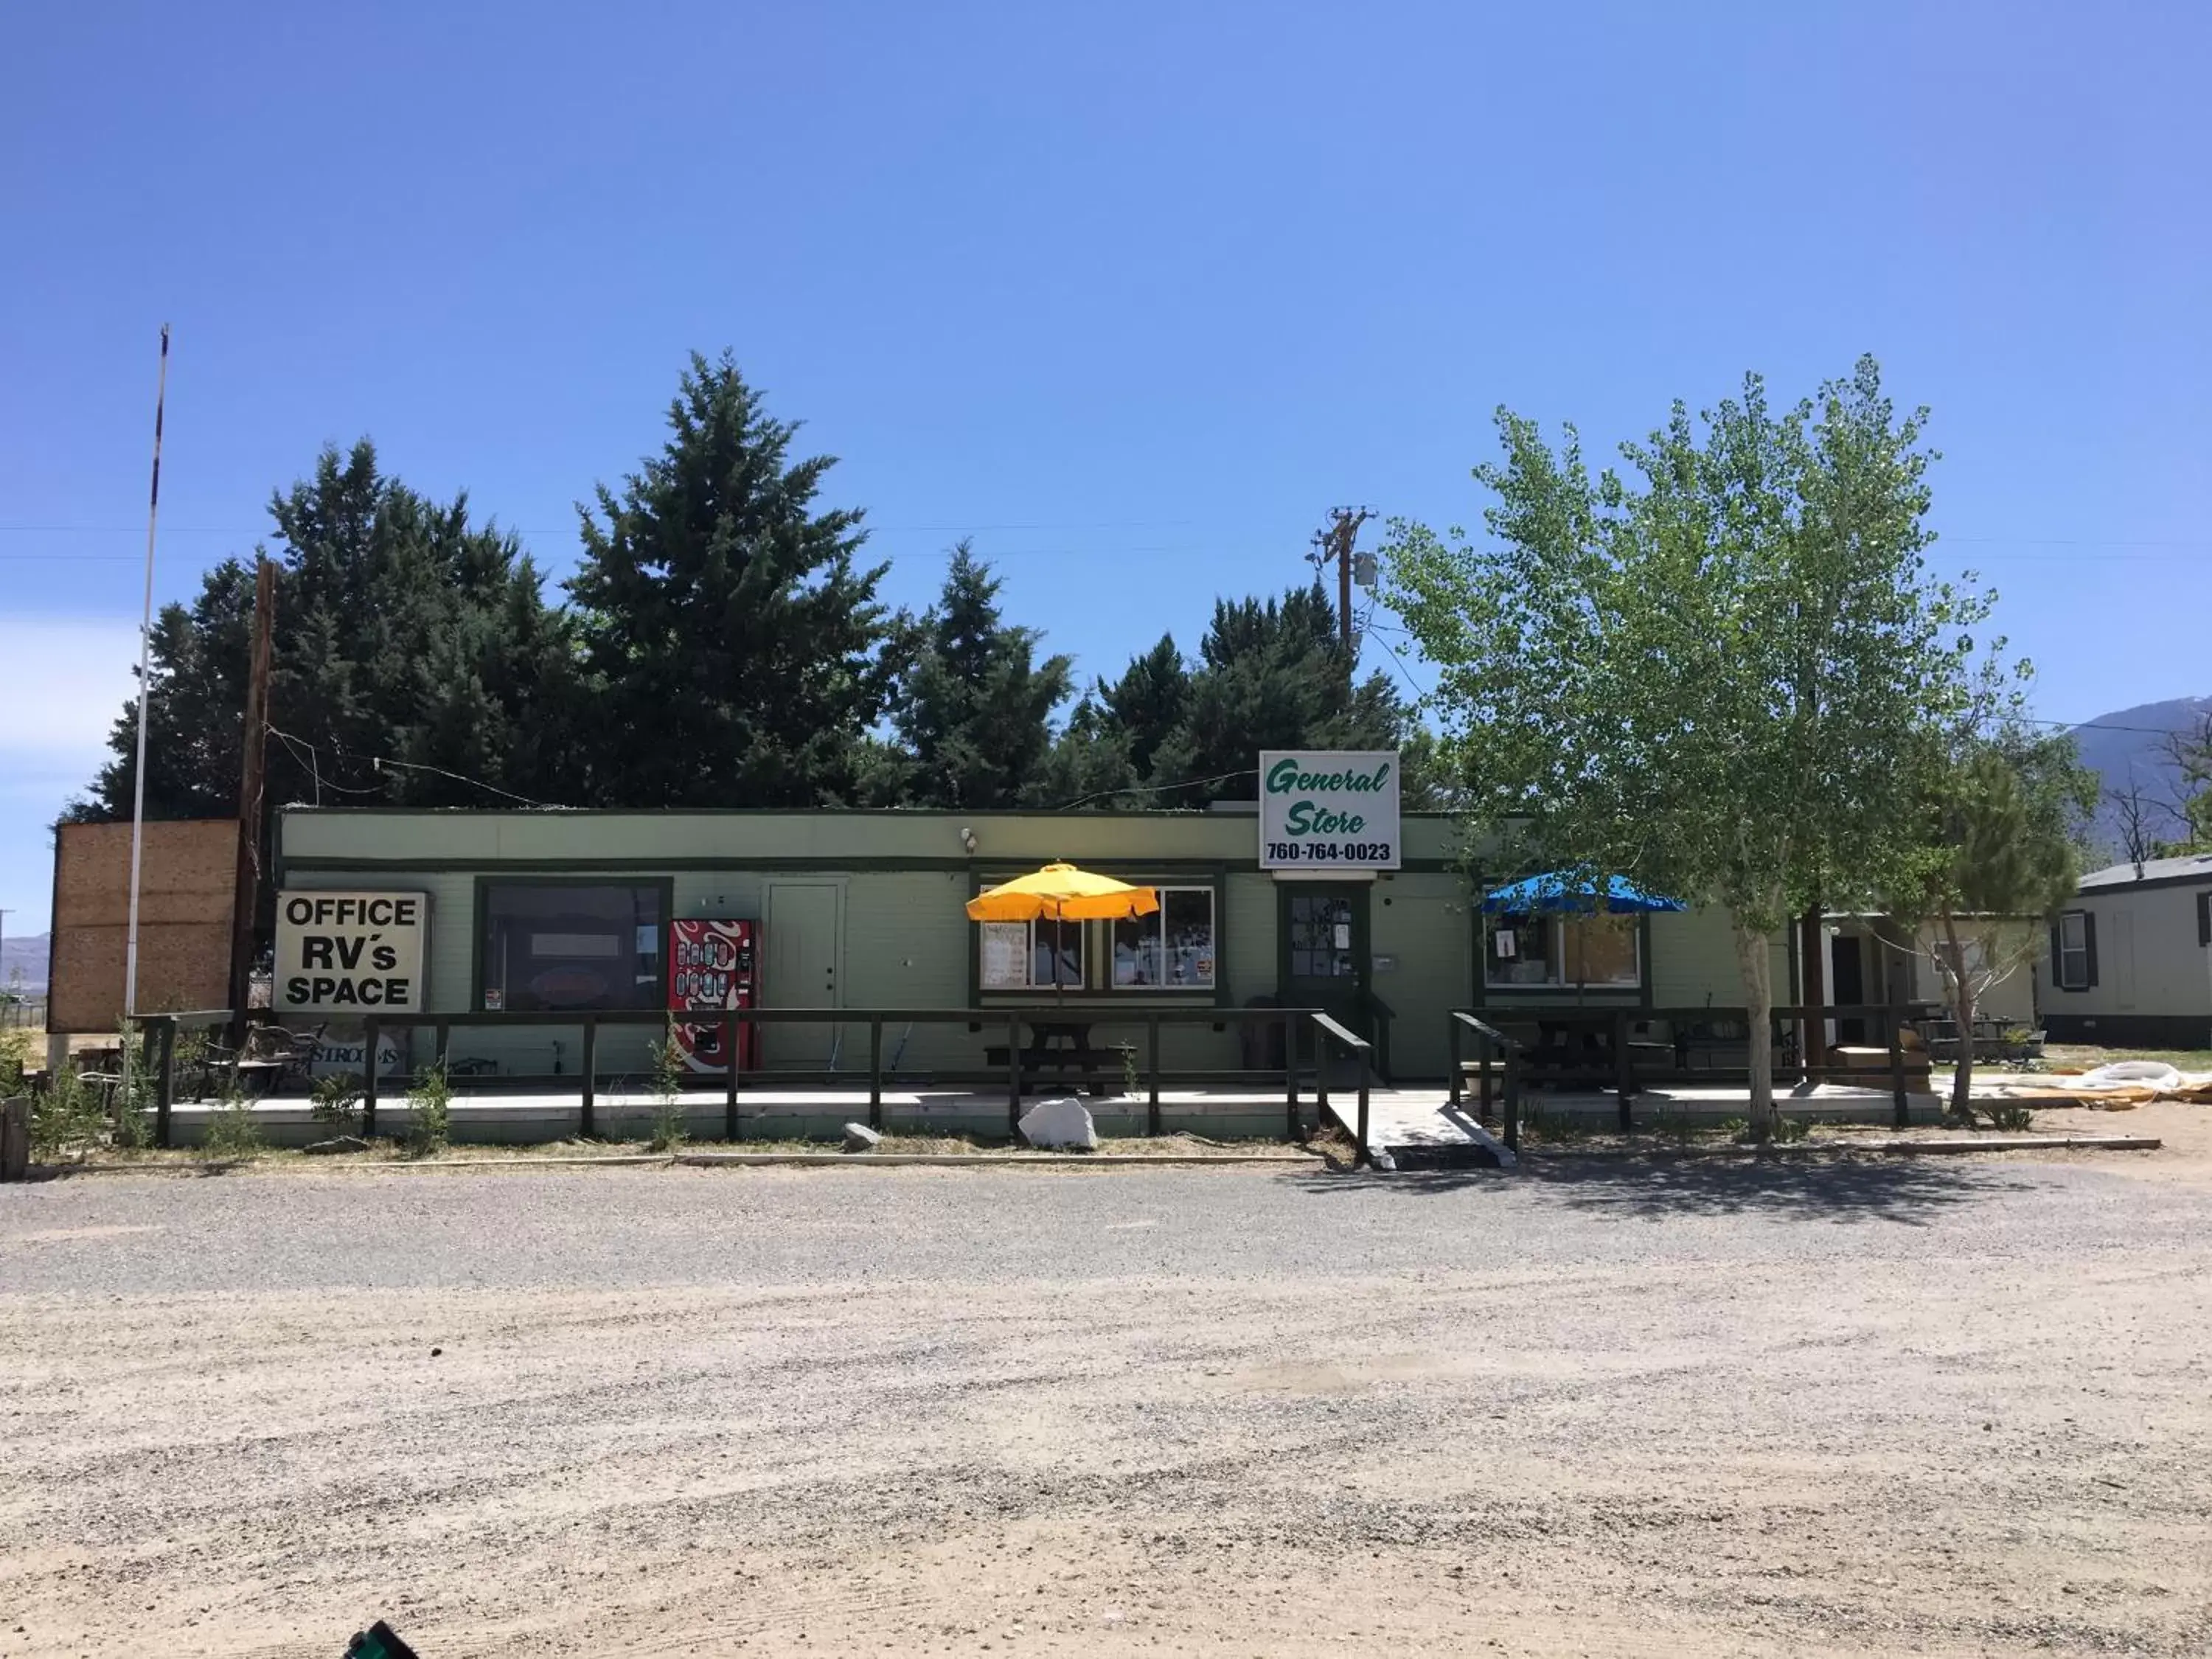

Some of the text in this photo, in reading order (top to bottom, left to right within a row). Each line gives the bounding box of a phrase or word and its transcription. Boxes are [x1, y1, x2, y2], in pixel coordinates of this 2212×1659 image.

[1266, 759, 1390, 794] General
[1284, 800, 1366, 836] Store
[1267, 843, 1391, 860] 760-764-0023
[286, 898, 416, 926] OFFICE
[302, 933, 397, 971] RV's
[285, 977, 409, 1006] SPACE
